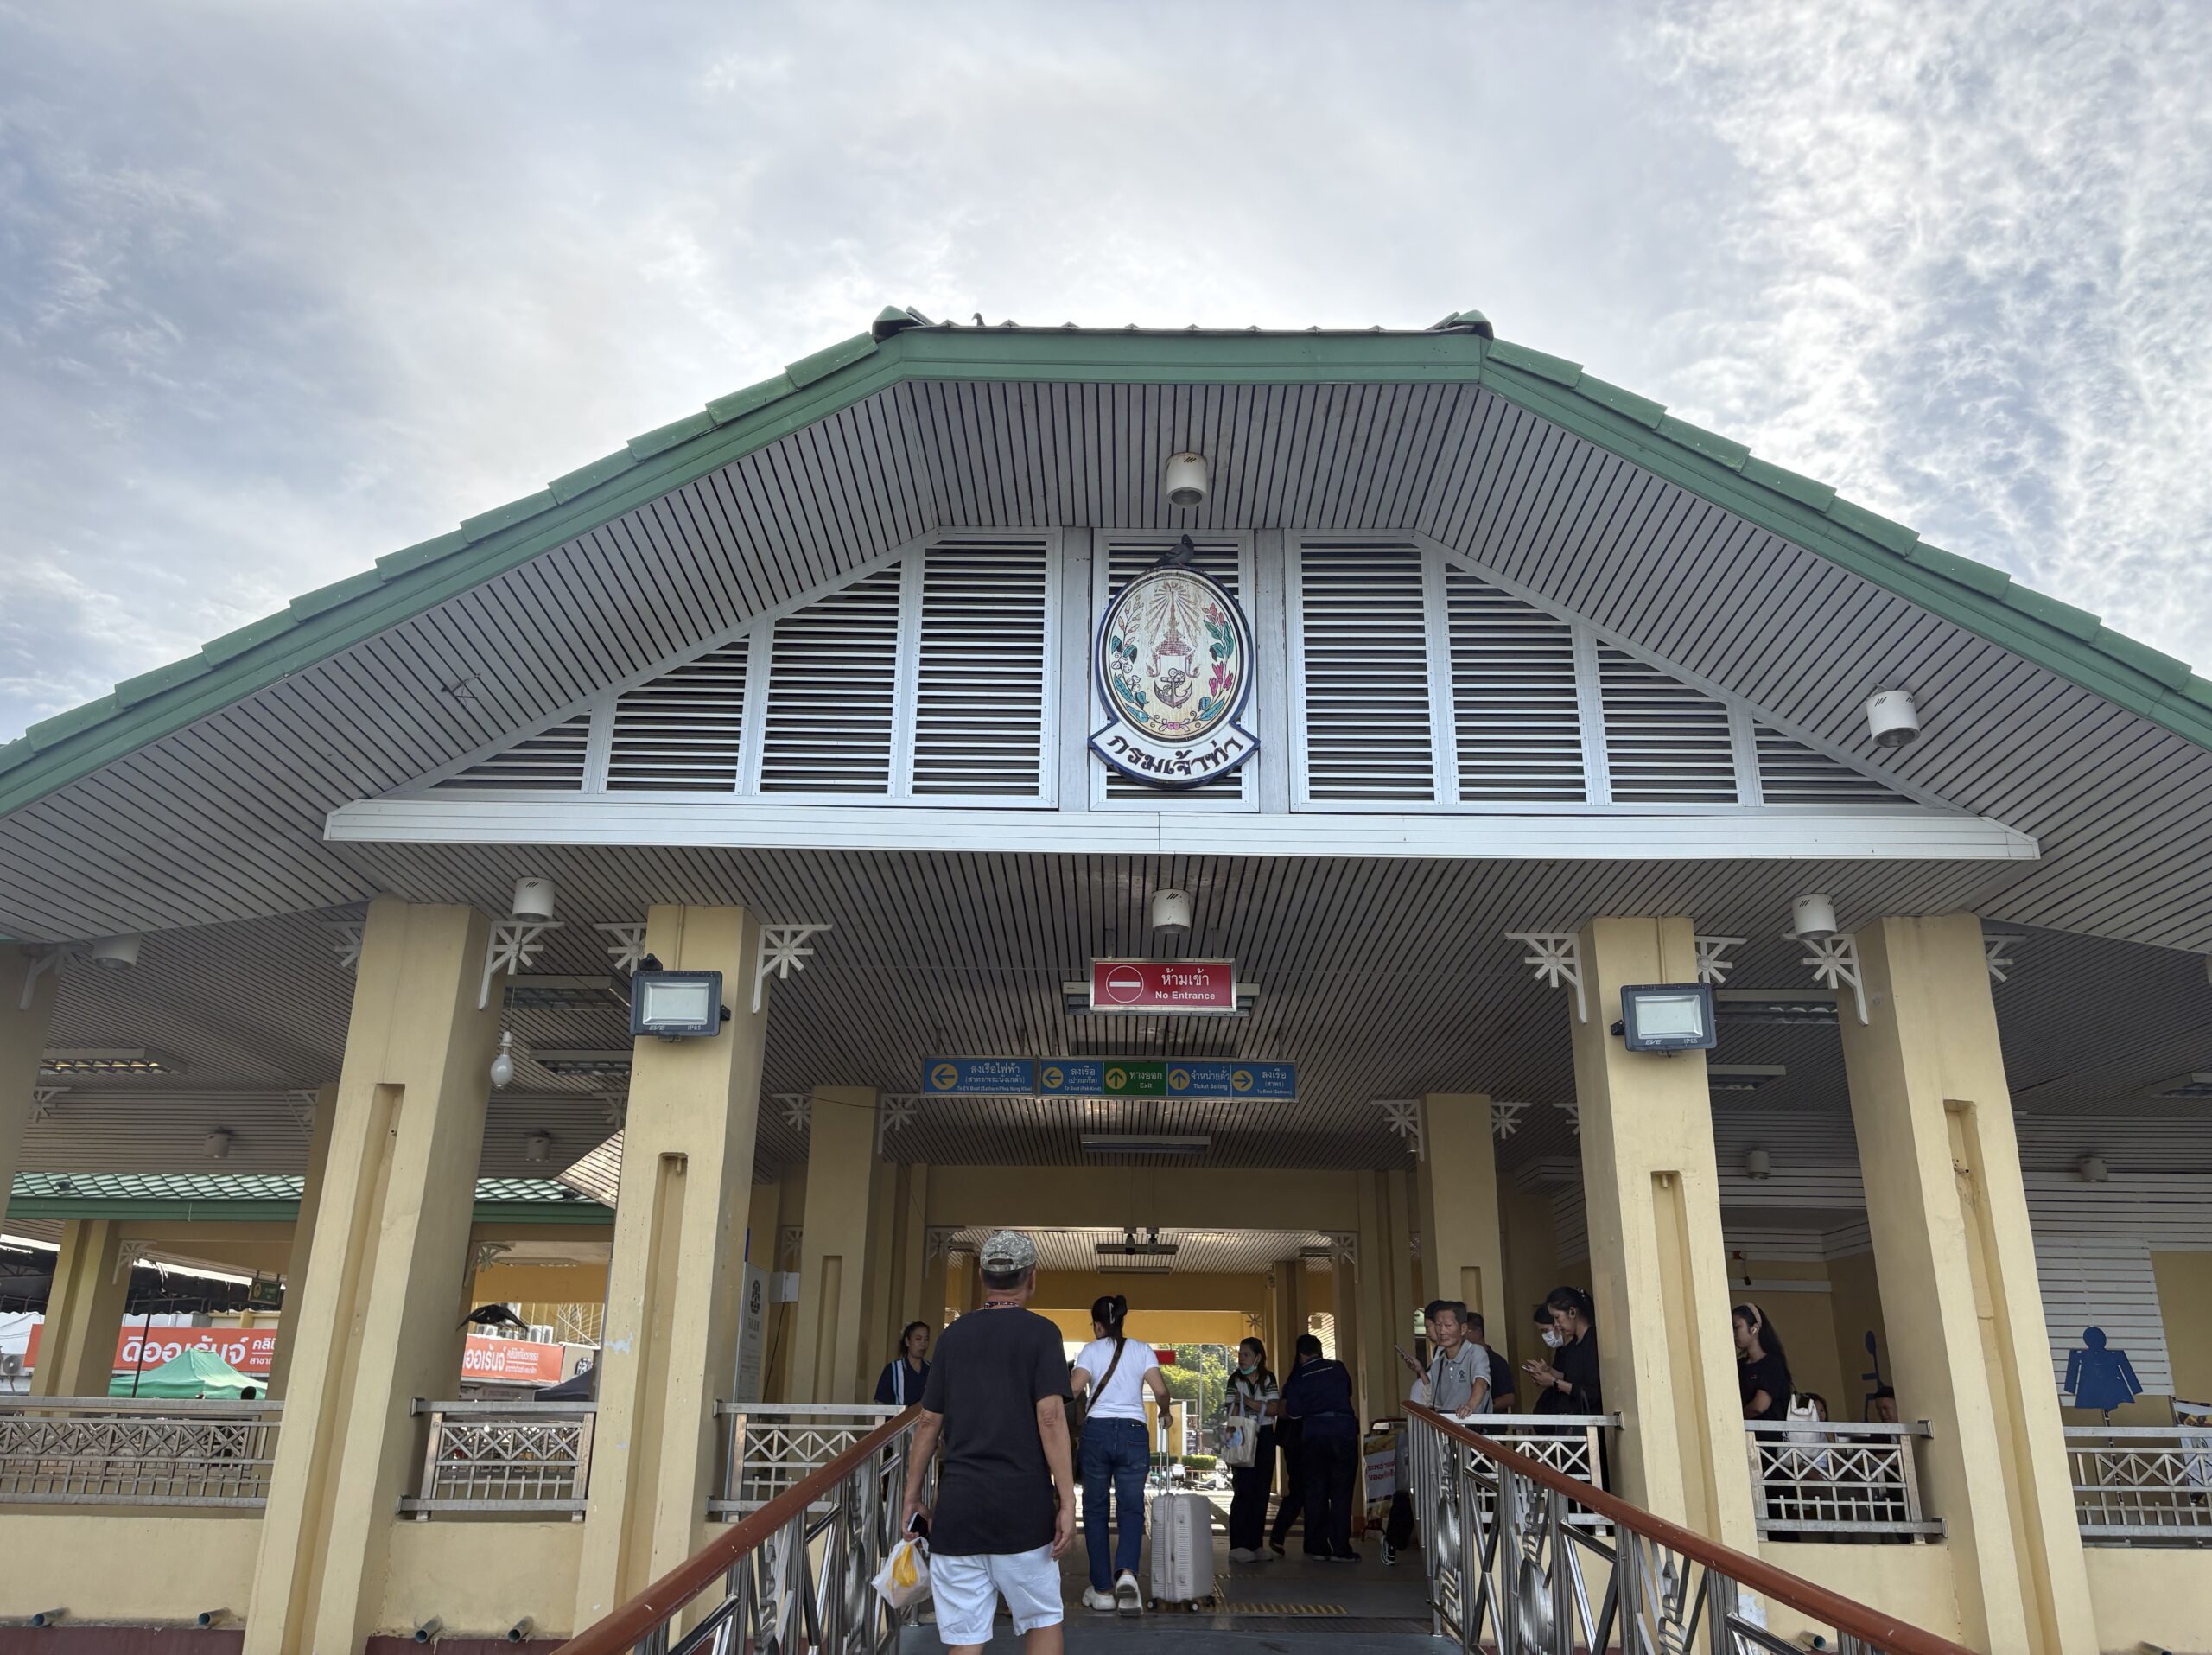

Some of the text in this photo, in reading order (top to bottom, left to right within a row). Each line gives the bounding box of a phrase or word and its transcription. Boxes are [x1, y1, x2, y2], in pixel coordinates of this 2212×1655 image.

[1106, 735, 1244, 776] กรมเจ้าท่า
[1161, 967, 1209, 986] ห้ามเข้า
[1155, 991, 1216, 1000] No Entrance
[970, 1062, 1020, 1073] ลงเรือไฟฟ้า
[1071, 1065, 1096, 1076] ลงเรือ
[1191, 1066, 1230, 1080] จำหน่ายตั๋ว
[1129, 1071, 1163, 1080] ทางออก
[1262, 1068, 1287, 1079] ลงเรือ
[463, 1343, 506, 1372] ออเร้นจ์
